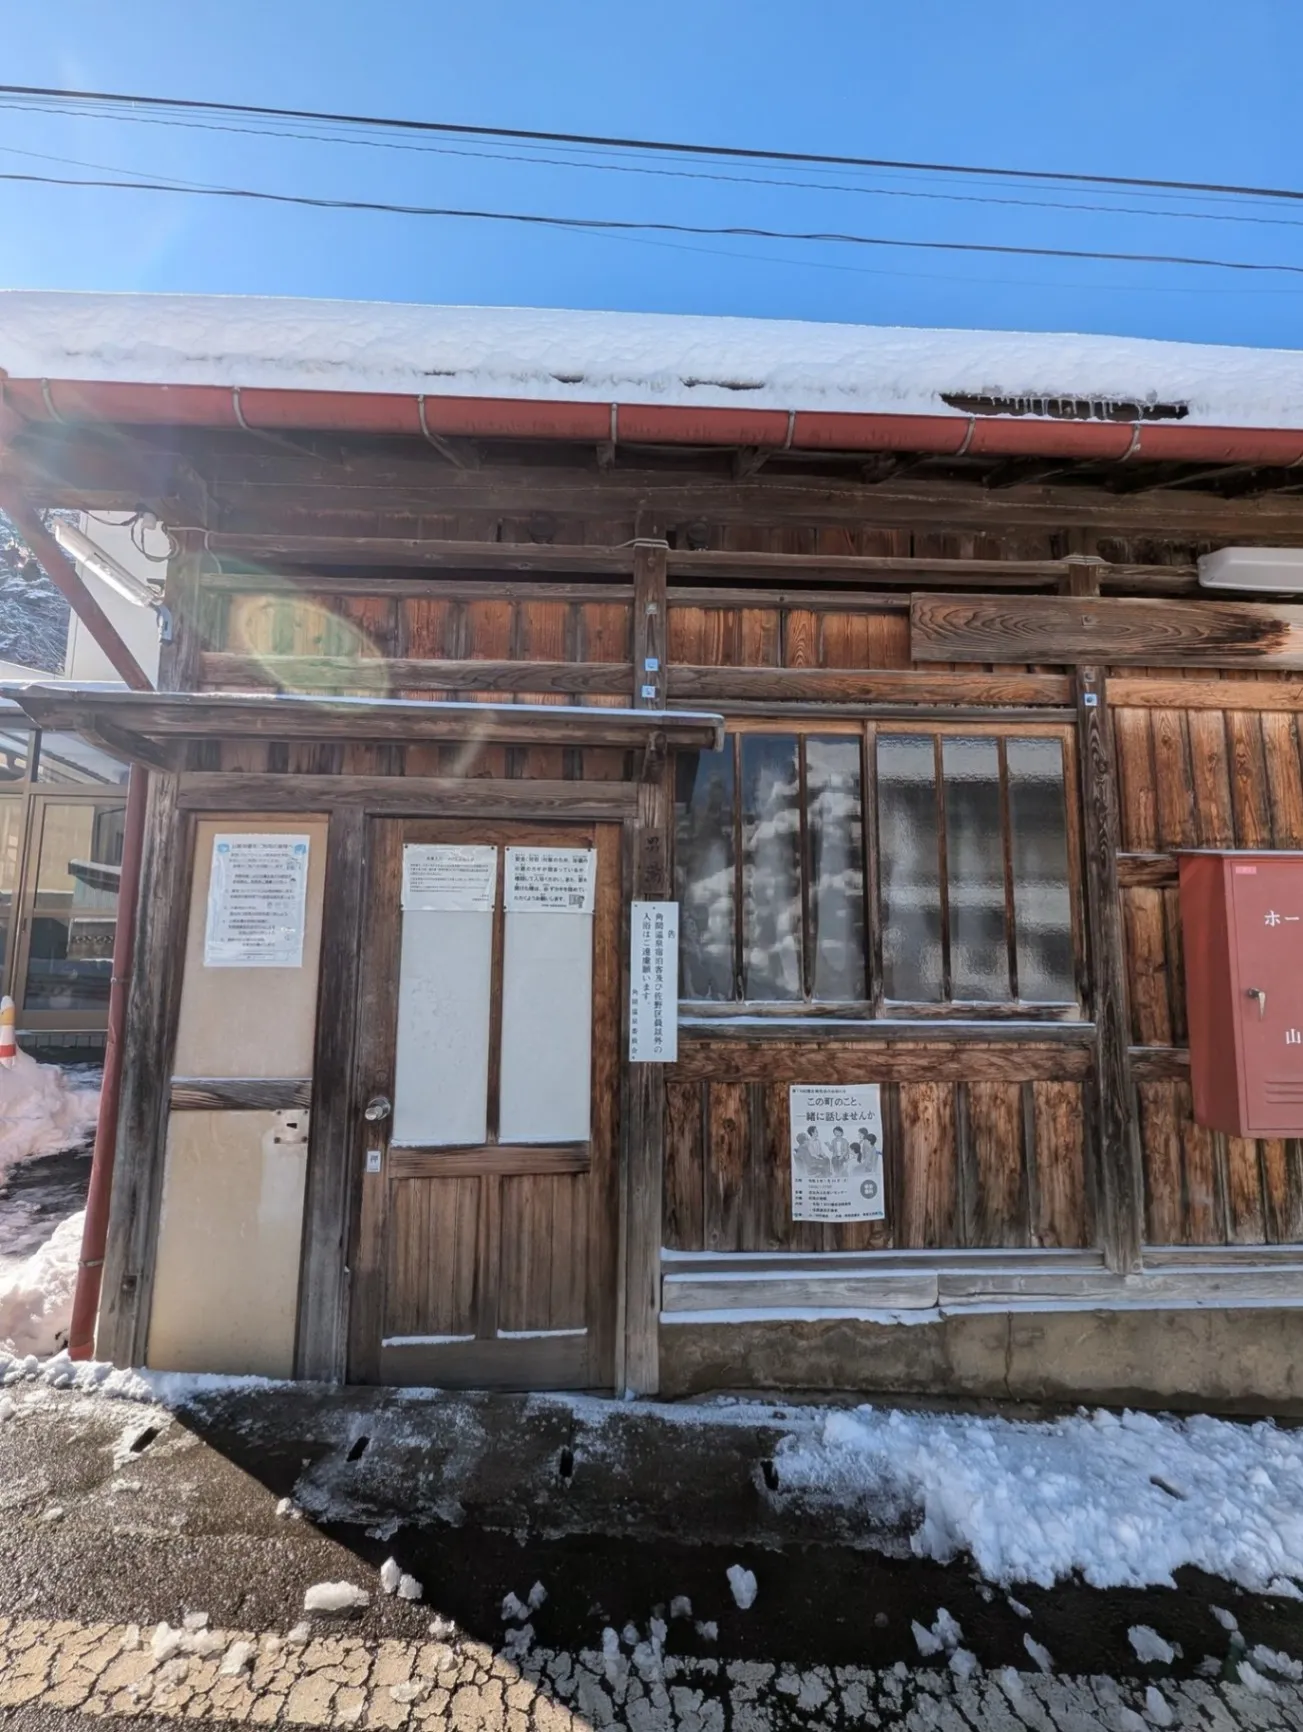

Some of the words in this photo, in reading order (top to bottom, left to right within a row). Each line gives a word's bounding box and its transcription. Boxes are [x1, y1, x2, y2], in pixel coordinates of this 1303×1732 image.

[1264, 909, 1300, 928] ホー
[641, 912, 651, 1006] 入浴はご遠慮願います。
[1285, 1028, 1302, 1045] 山
[807, 1097, 863, 1108] この町のこと、
[796, 1110, 876, 1122] 一緒に話しませんか
